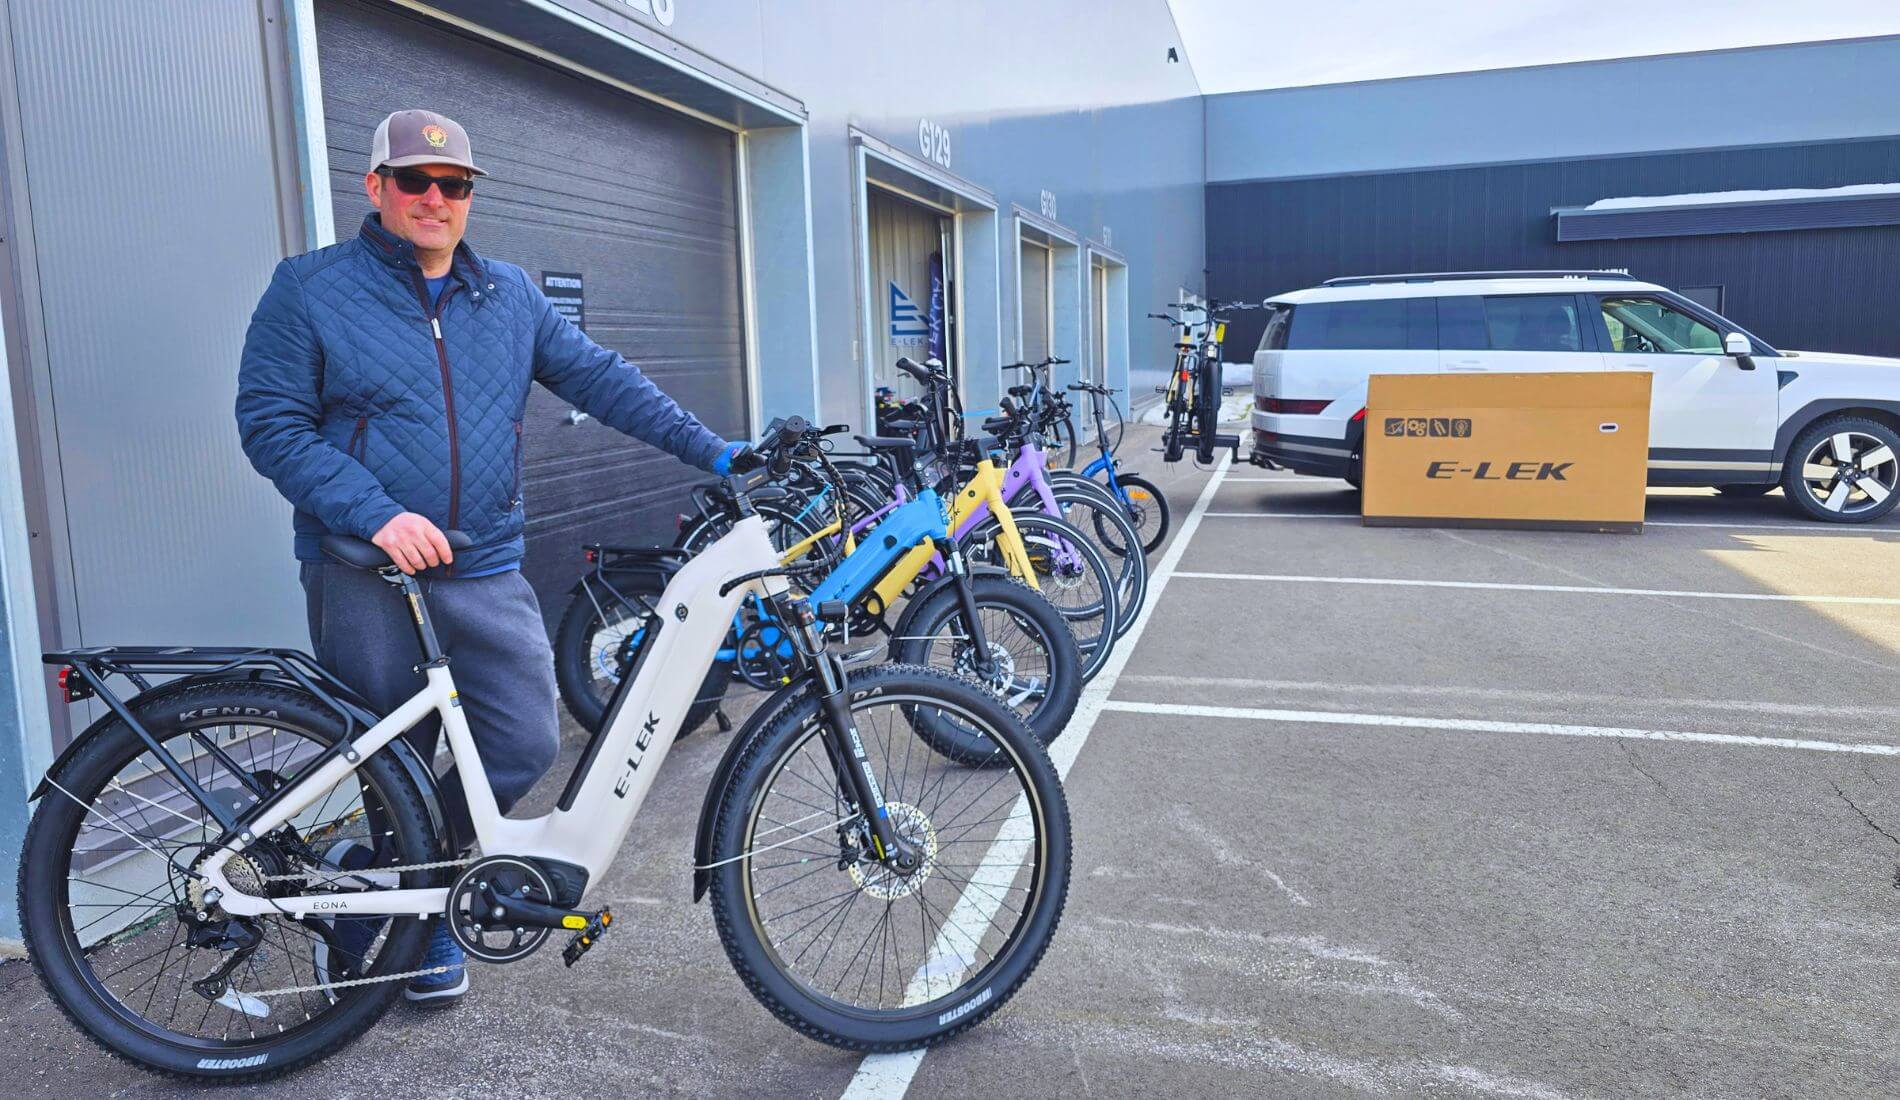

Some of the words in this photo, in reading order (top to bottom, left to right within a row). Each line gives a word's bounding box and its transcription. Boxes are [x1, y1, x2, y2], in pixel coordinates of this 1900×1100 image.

[918, 118, 951, 168] G129
[1425, 461, 1575, 481] E-LEK
[179, 706, 279, 721] KENDA
[613, 710, 660, 799] E-LEK
[313, 901, 348, 910] EONA
[938, 993, 983, 1026] BOOSTER
[196, 1055, 257, 1070] BOOSTER
